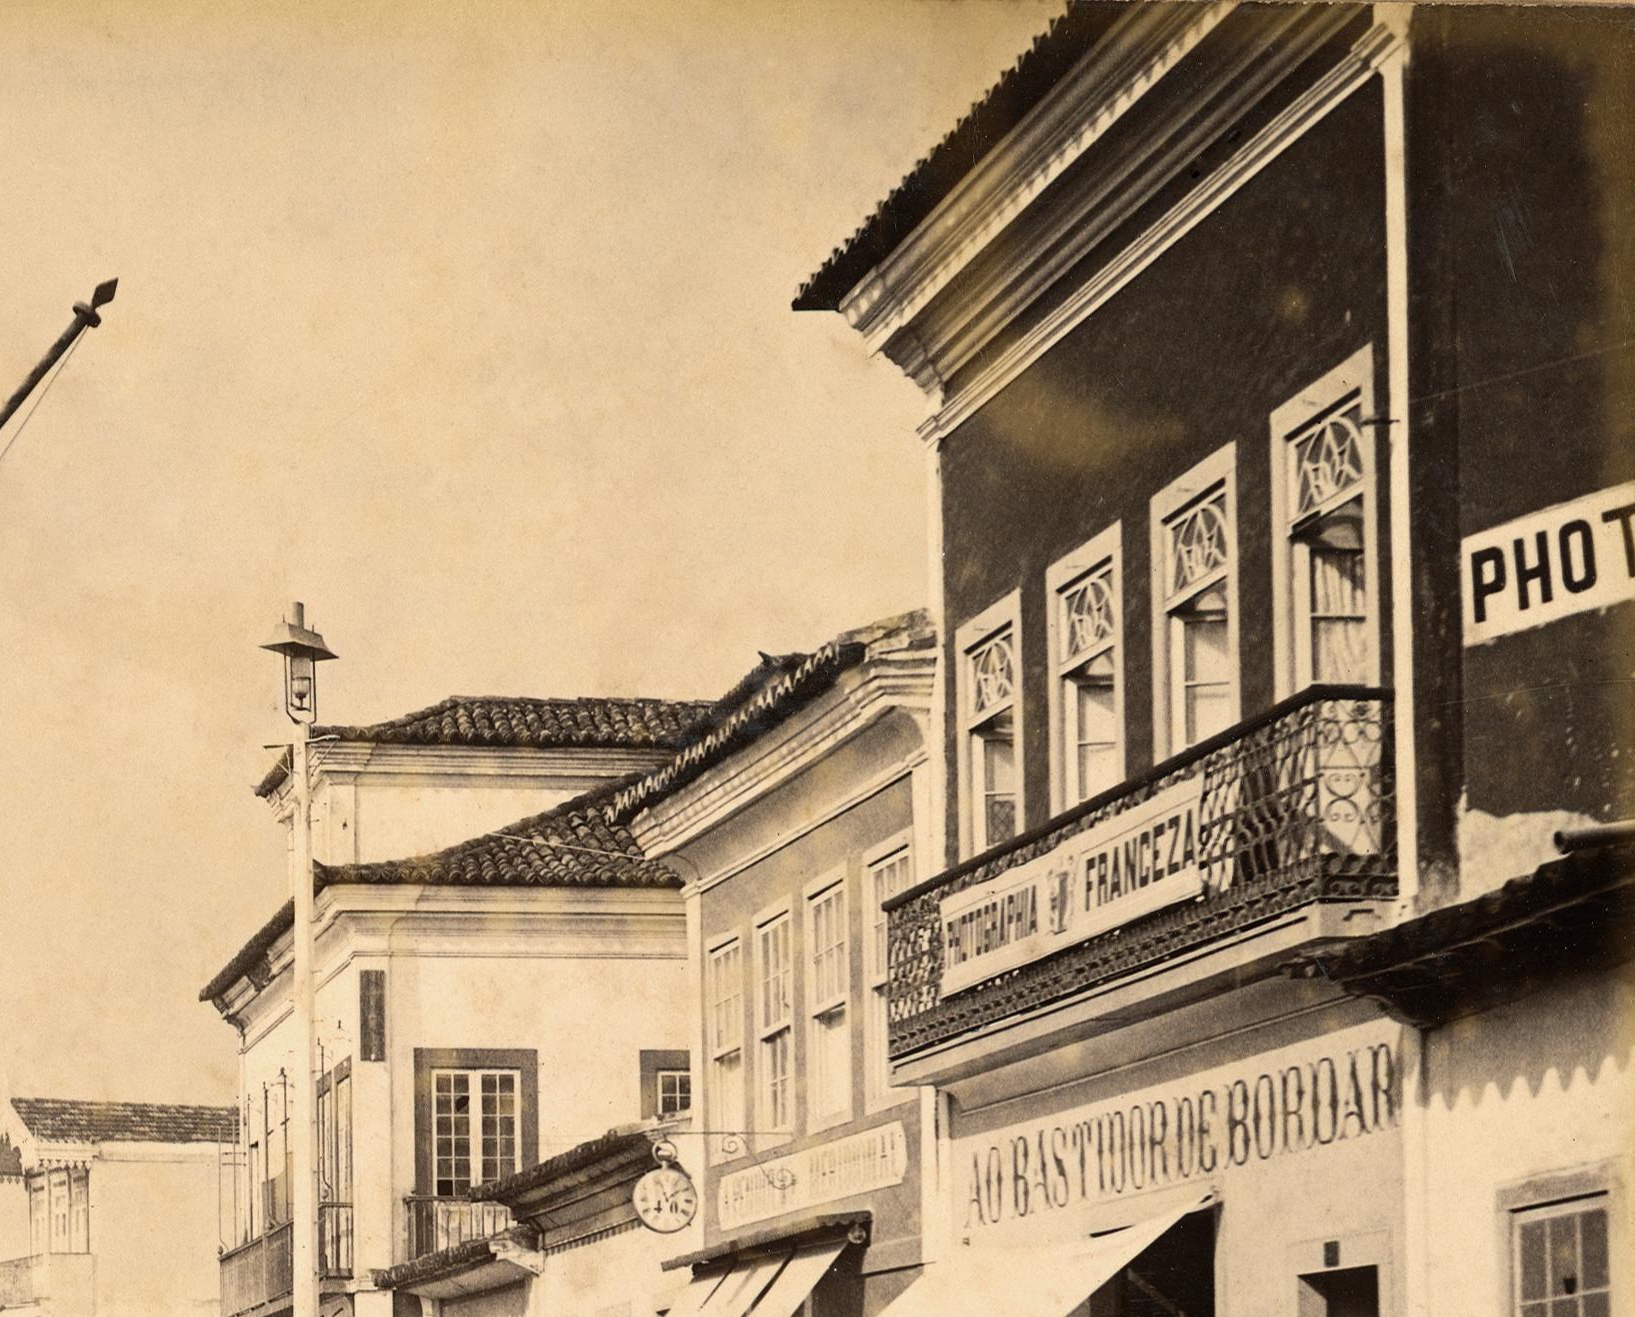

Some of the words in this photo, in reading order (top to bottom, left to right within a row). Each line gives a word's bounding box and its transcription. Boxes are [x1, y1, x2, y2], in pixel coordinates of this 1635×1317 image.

[1471, 501, 1635, 624] PHOT
[1085, 808, 1198, 912] FRANCEZA
[963, 1144, 1003, 1230] AO
[1010, 1099, 1168, 1219] BASTIDOR
[1176, 1088, 1219, 1179] DE
[1223, 1042, 1403, 1167] BORDAR
